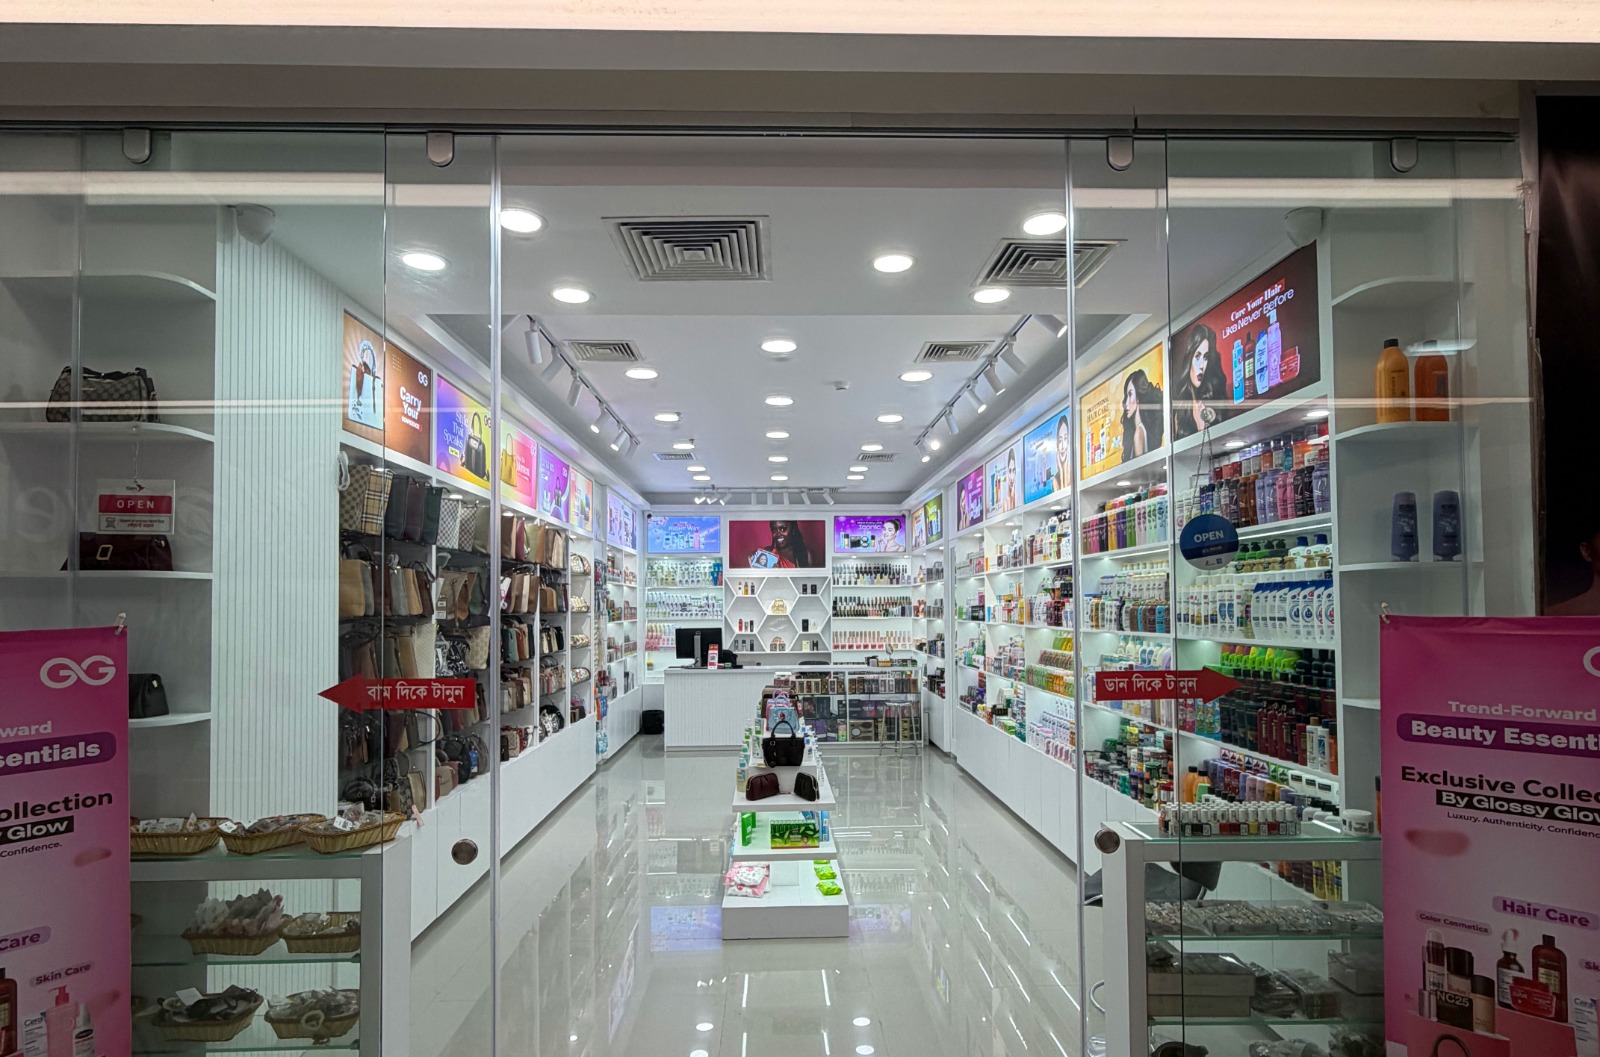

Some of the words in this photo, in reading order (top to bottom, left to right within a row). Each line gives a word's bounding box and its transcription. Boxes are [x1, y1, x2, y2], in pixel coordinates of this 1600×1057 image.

[1246, 294, 1264, 312] Your
[1264, 283, 1283, 301] Hair
[1237, 308, 1262, 329] Never
[1263, 289, 1294, 314] Before
[399, 386, 422, 412] Carry
[402, 401, 419, 420] Your
[116, 499, 155, 509] OPEN
[1193, 530, 1224, 543] OPEN
[366, 685, 392, 701] বাম
[395, 680, 428, 701] দিকে
[431, 680, 465, 703] টানুন
[1103, 676, 1129, 693] ডান
[1131, 673, 1162, 693] দিকে
[1448, 700, 1597, 722] Trend-Forward
[1411, 719, 1497, 746] Beauty
[1401, 765, 1516, 794] Exclusive
[1441, 791, 1469, 808] By
[1472, 798, 1550, 818] Glossy
[7, 820, 69, 840] Glow
[1447, 811, 1481, 823] Luxury.
[1482, 816, 1545, 832] Authenticity.
[0, 842, 63, 858] Confidence.
[1419, 913, 1443, 924] Color
[1443, 918, 1489, 934] Cosmetics
[1502, 899, 1540, 918] Hair
[1545, 908, 1590, 928] Care
[35, 971, 62, 985] Skin
[64, 964, 92, 977] Care
[1436, 990, 1470, 1008] NC25
